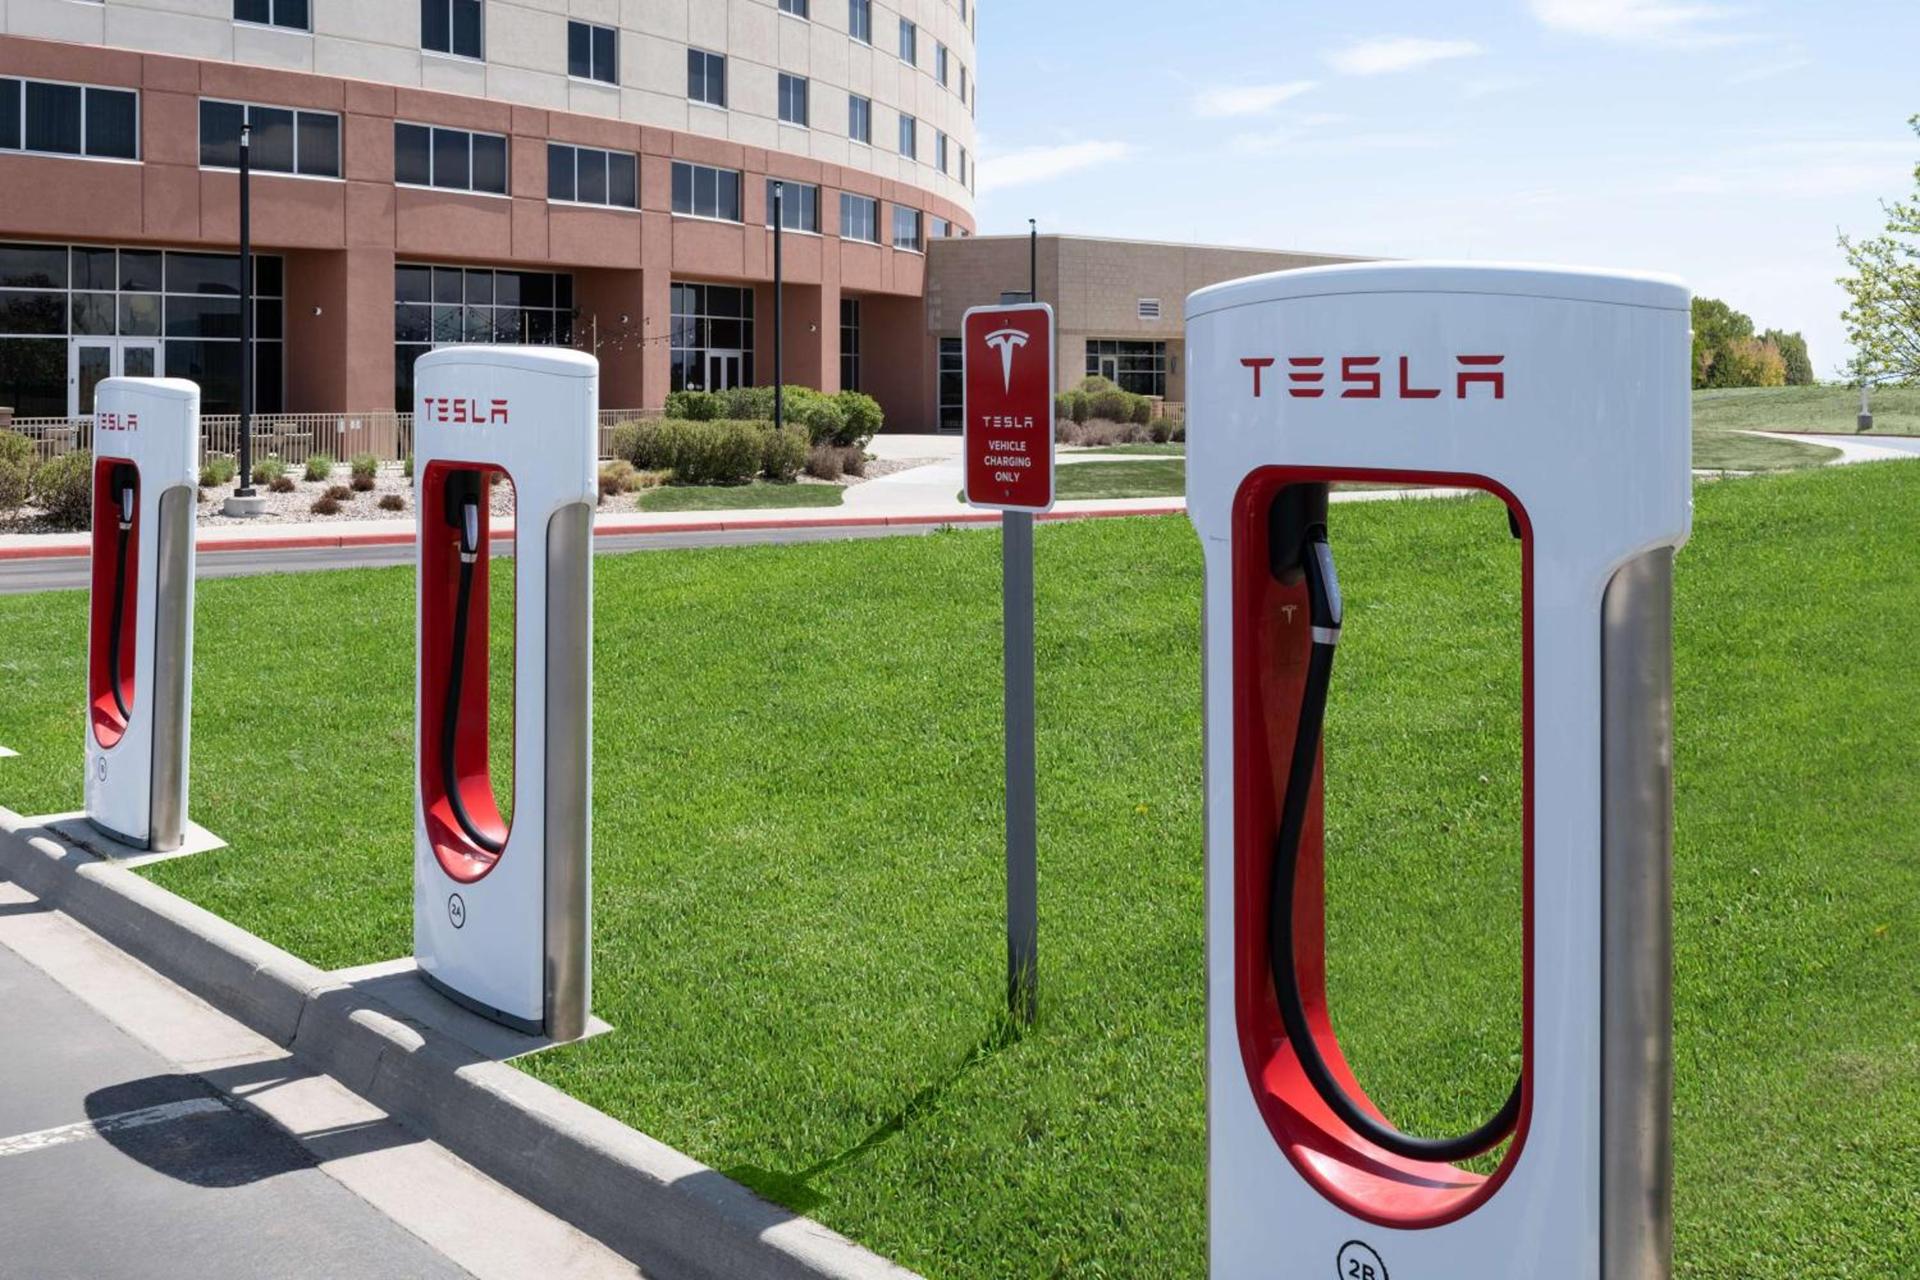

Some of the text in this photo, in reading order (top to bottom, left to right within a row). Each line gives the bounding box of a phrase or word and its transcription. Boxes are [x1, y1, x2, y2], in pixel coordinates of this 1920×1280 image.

[1240, 355, 1505, 399] TESLA
[424, 398, 508, 424] TESLA
[982, 416, 1033, 429] TESLA
[988, 440, 1026, 452] VEHICLE
[984, 455, 1032, 467] CHARGING
[995, 471, 1021, 482] ONLY
[1348, 1258, 1376, 1280] 2B
